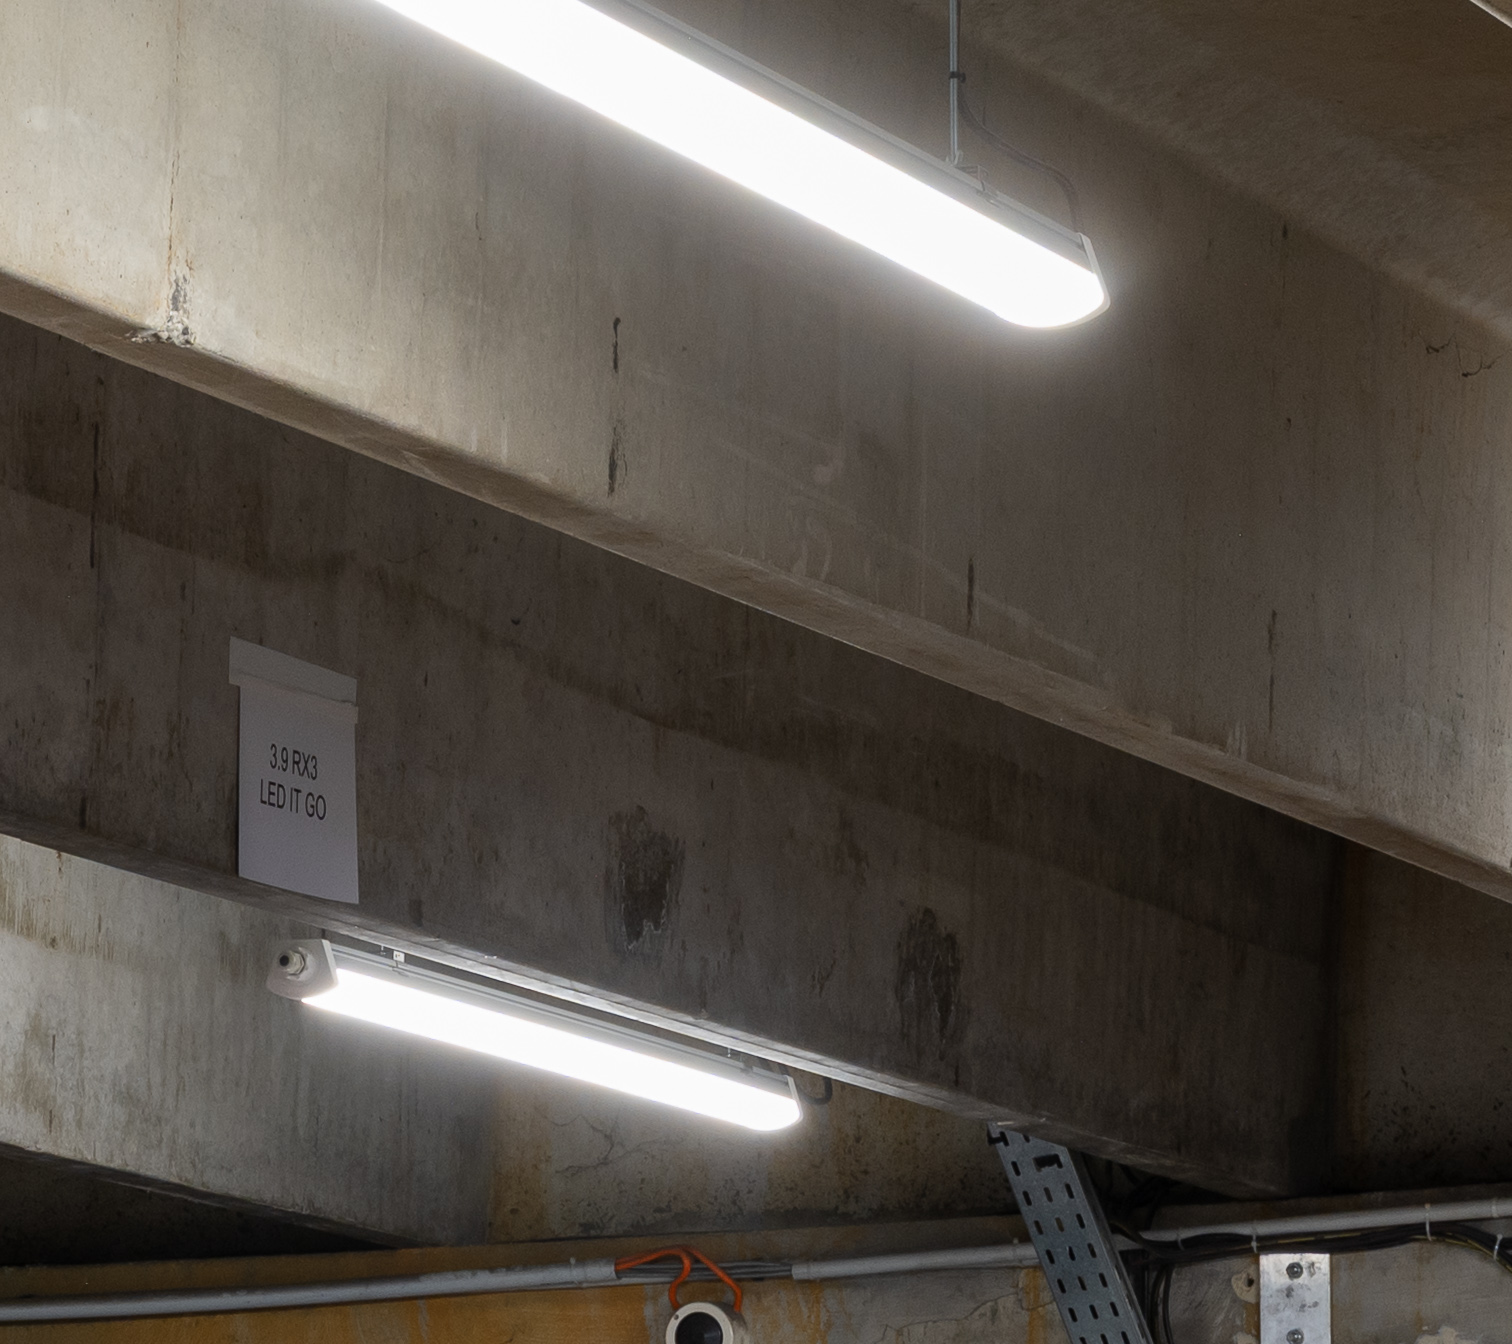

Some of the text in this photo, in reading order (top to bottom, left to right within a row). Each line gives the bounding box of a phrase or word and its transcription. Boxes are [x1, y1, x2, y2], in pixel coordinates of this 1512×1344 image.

[269, 743, 318, 781] 3.9 RX3
[259, 778, 327, 821] LED IT GO
